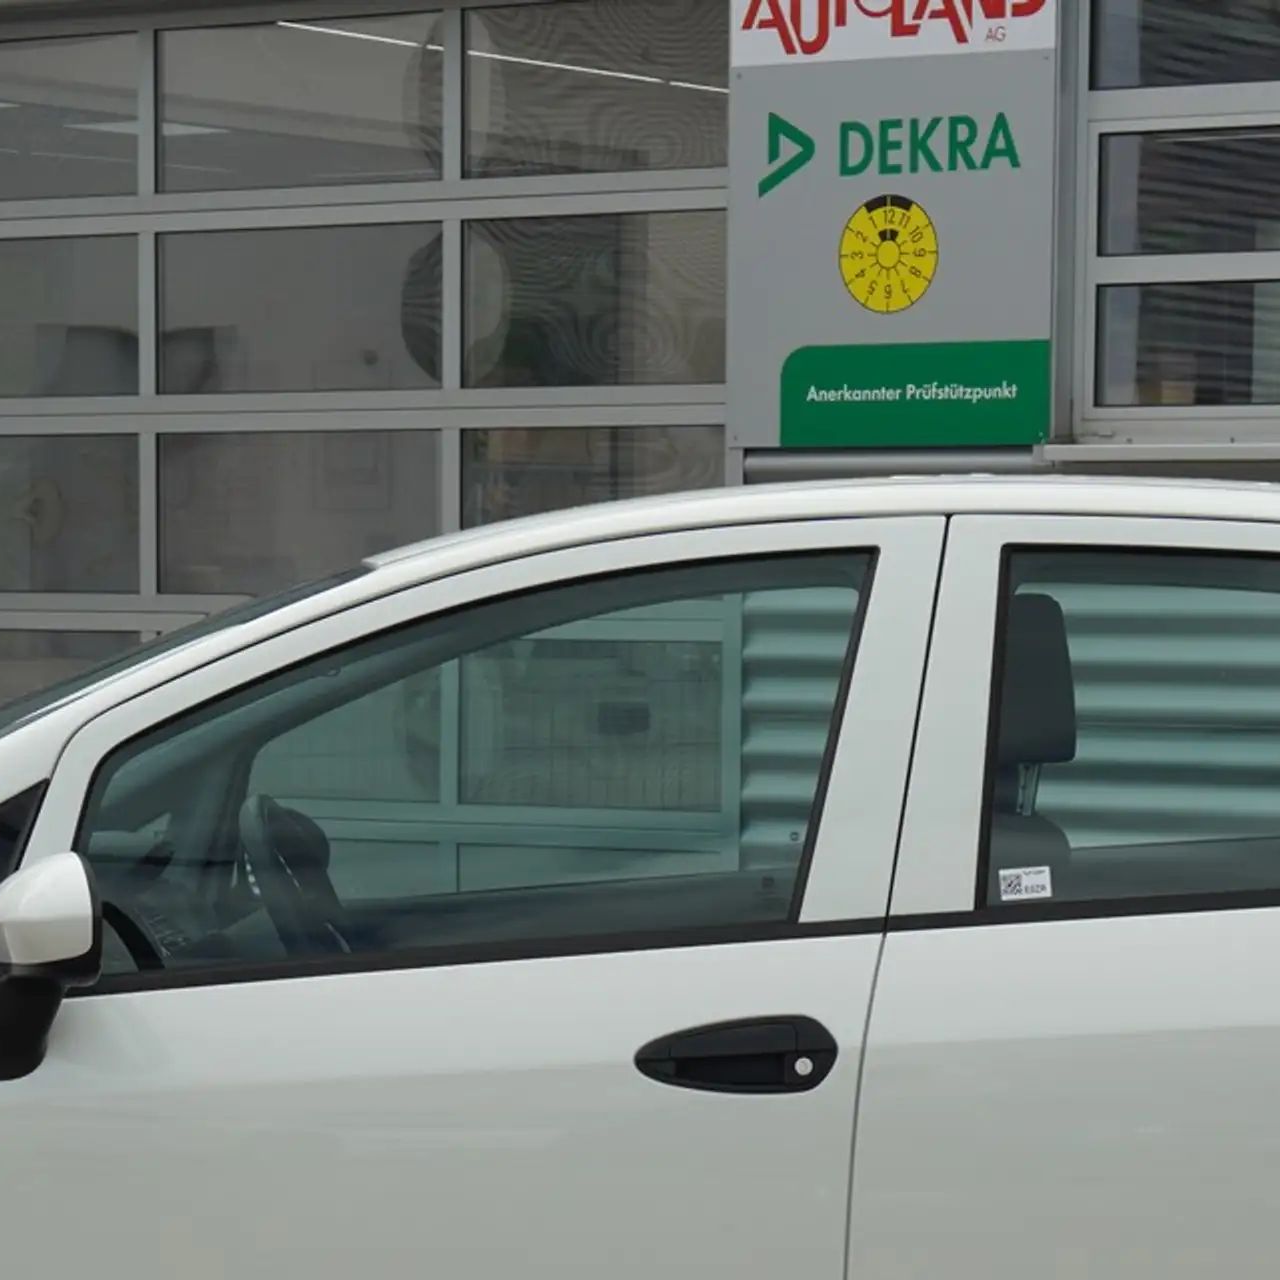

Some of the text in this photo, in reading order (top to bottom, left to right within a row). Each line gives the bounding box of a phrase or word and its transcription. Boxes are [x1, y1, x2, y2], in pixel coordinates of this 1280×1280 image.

[984, 26, 1007, 43] AG
[839, 112, 1021, 177] DEKRA
[882, 208, 896, 225] 12
[898, 212, 912, 229] 11
[855, 230, 869, 243] 2
[908, 225, 924, 244] 10
[850, 251, 865, 260] 3
[806, 380, 1018, 404] Anerkannter Prüfstützpunkt
